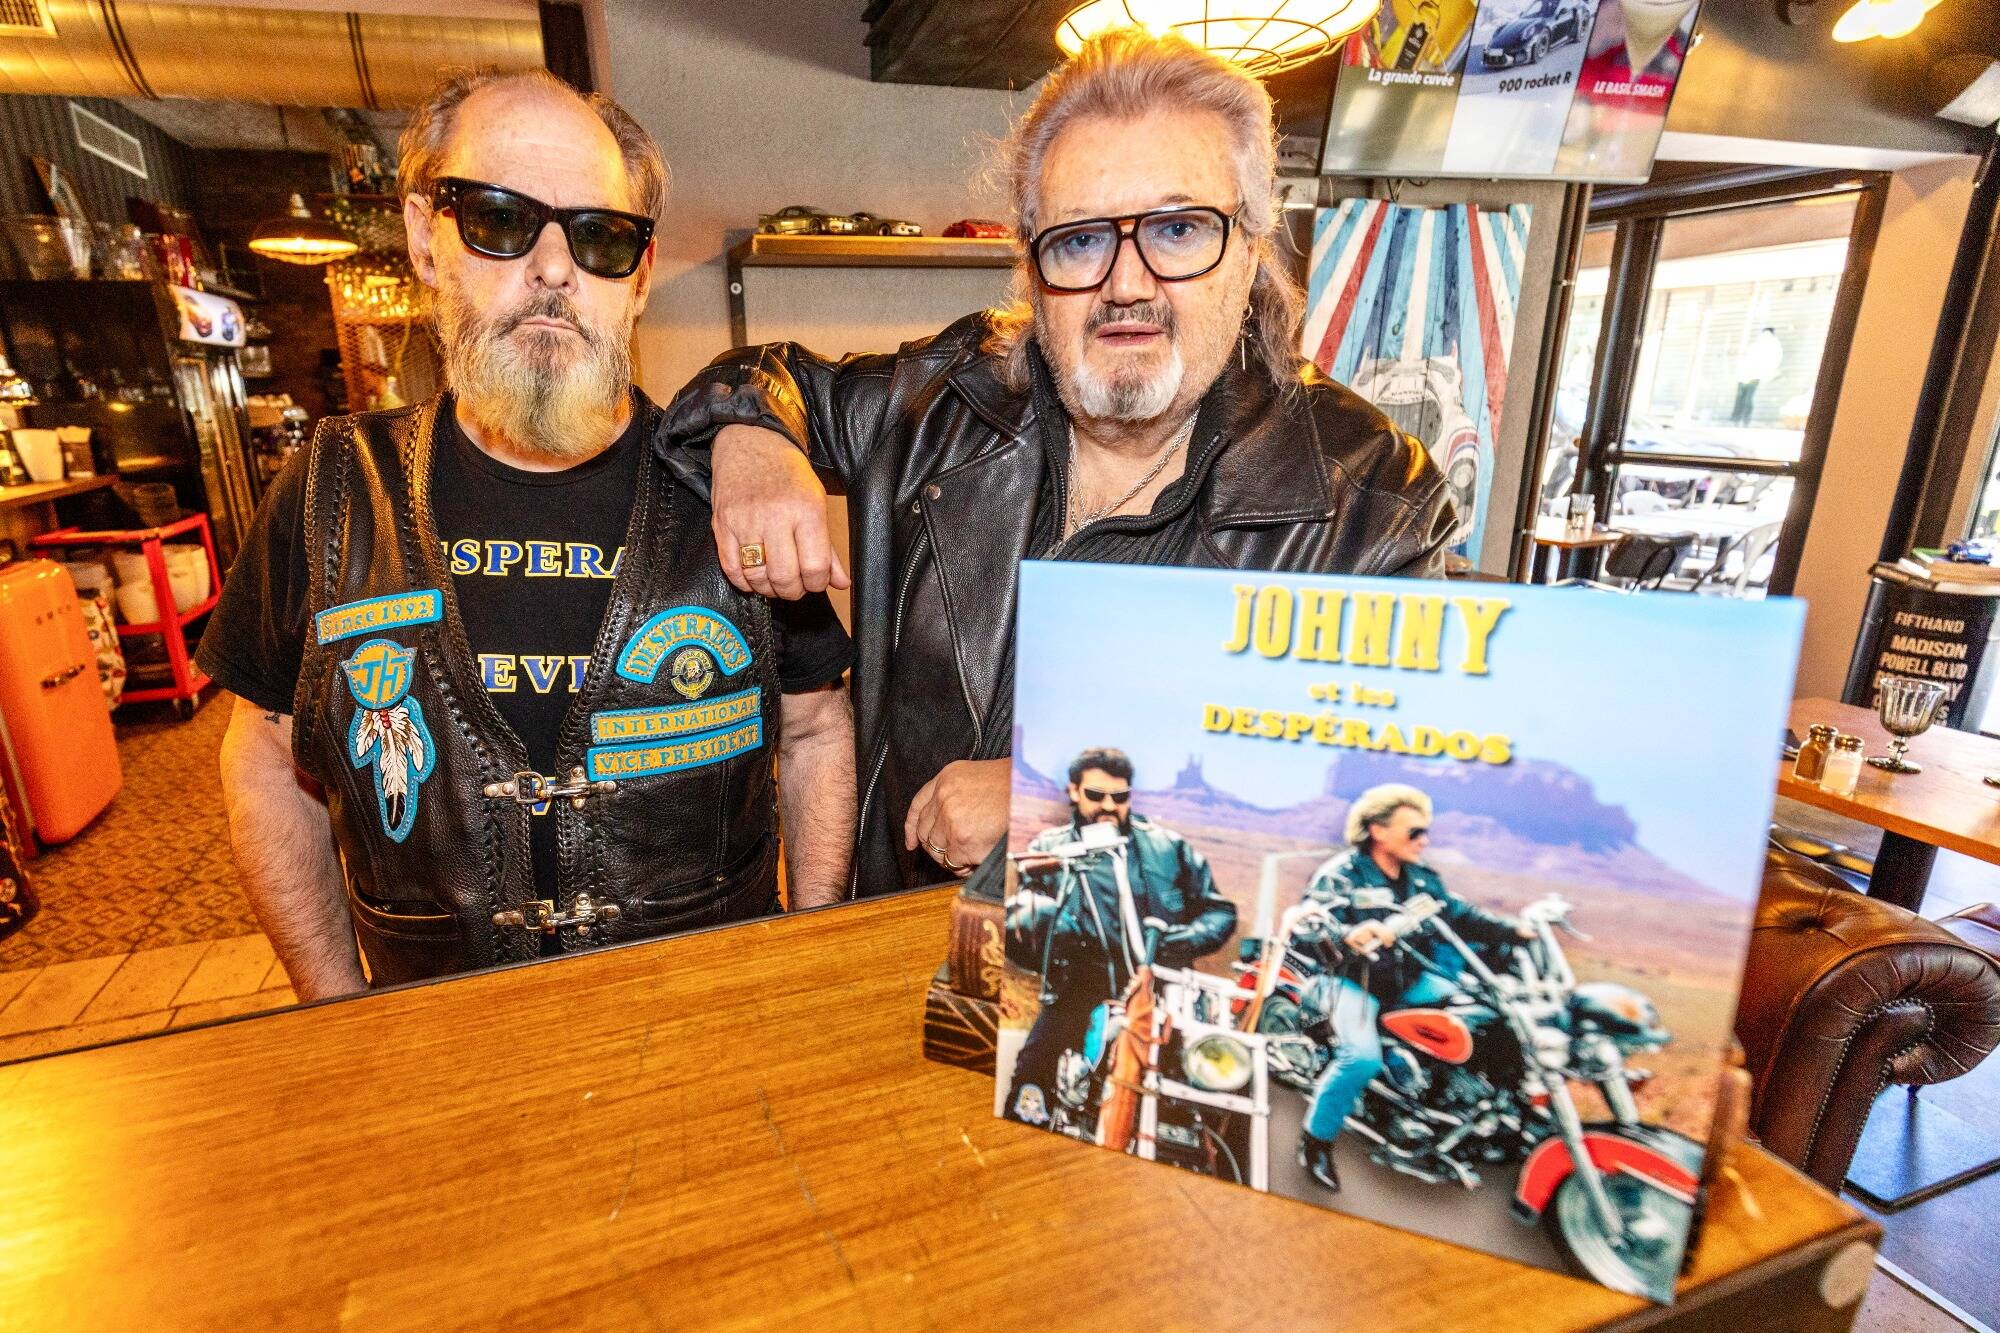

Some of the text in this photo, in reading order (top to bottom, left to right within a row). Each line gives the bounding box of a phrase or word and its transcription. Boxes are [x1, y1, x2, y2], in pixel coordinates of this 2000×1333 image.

[1368, 68, 1455, 86] La grande cuvée
[1499, 71, 1572, 93] 900 rocket R
[1593, 81, 1666, 97] LE BASIL SMASH
[440, 538, 626, 579] SPER
[321, 600, 429, 632] Since 1992
[1223, 584, 1511, 675] JOHNNY
[629, 616, 741, 672] DESPERADOS
[1890, 634, 1968, 660] MADISON
[1880, 652, 1968, 680] POWELL BLVD
[1308, 683, 1341, 702] et
[602, 699, 757, 735] INTERNATIONAL
[1202, 703, 1511, 764] DESPÉRADOS
[600, 731, 754, 771] VICE PRESIDENT
